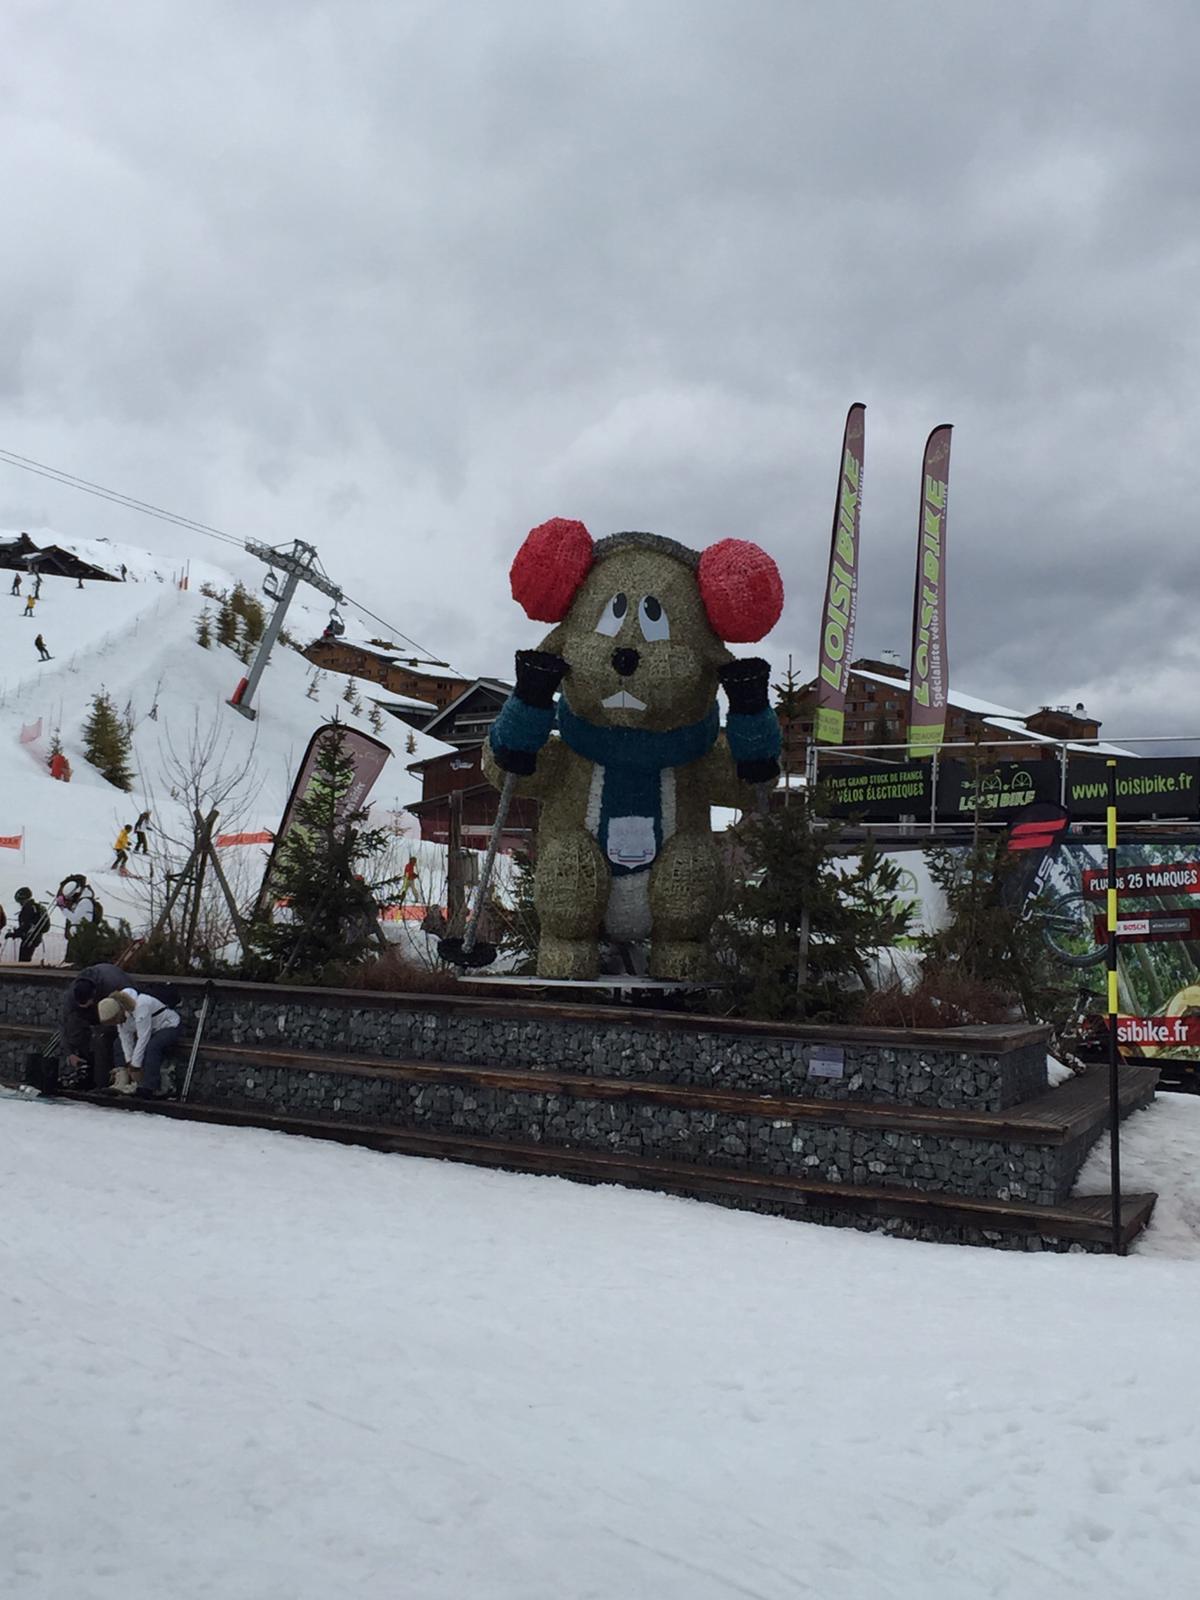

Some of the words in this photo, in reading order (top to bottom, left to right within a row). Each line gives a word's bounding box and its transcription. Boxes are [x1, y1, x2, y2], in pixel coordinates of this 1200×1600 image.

[835, 448, 860, 568] BIKE
[922, 474, 945, 585] BIKE
[821, 560, 853, 691] LOISI
[930, 608, 939, 641] vélos
[930, 643, 945, 708] Spécialiste
[848, 775, 868, 787] GRAND
[889, 772, 898, 783] DE
[899, 770, 924, 782] FRANCE
[1072, 772, 1193, 800] wwwloisibike.fr
[837, 787, 865, 803] VÉLOS
[866, 782, 925, 801] ÉLECTRIQUES
[1000, 790, 1036, 808] BIKE
[1127, 873, 1144, 889] 25
[1146, 870, 1198, 888] MARQUES
[1122, 923, 1147, 932] BOSCH
[1117, 1020, 1189, 1042] sibike.fr
